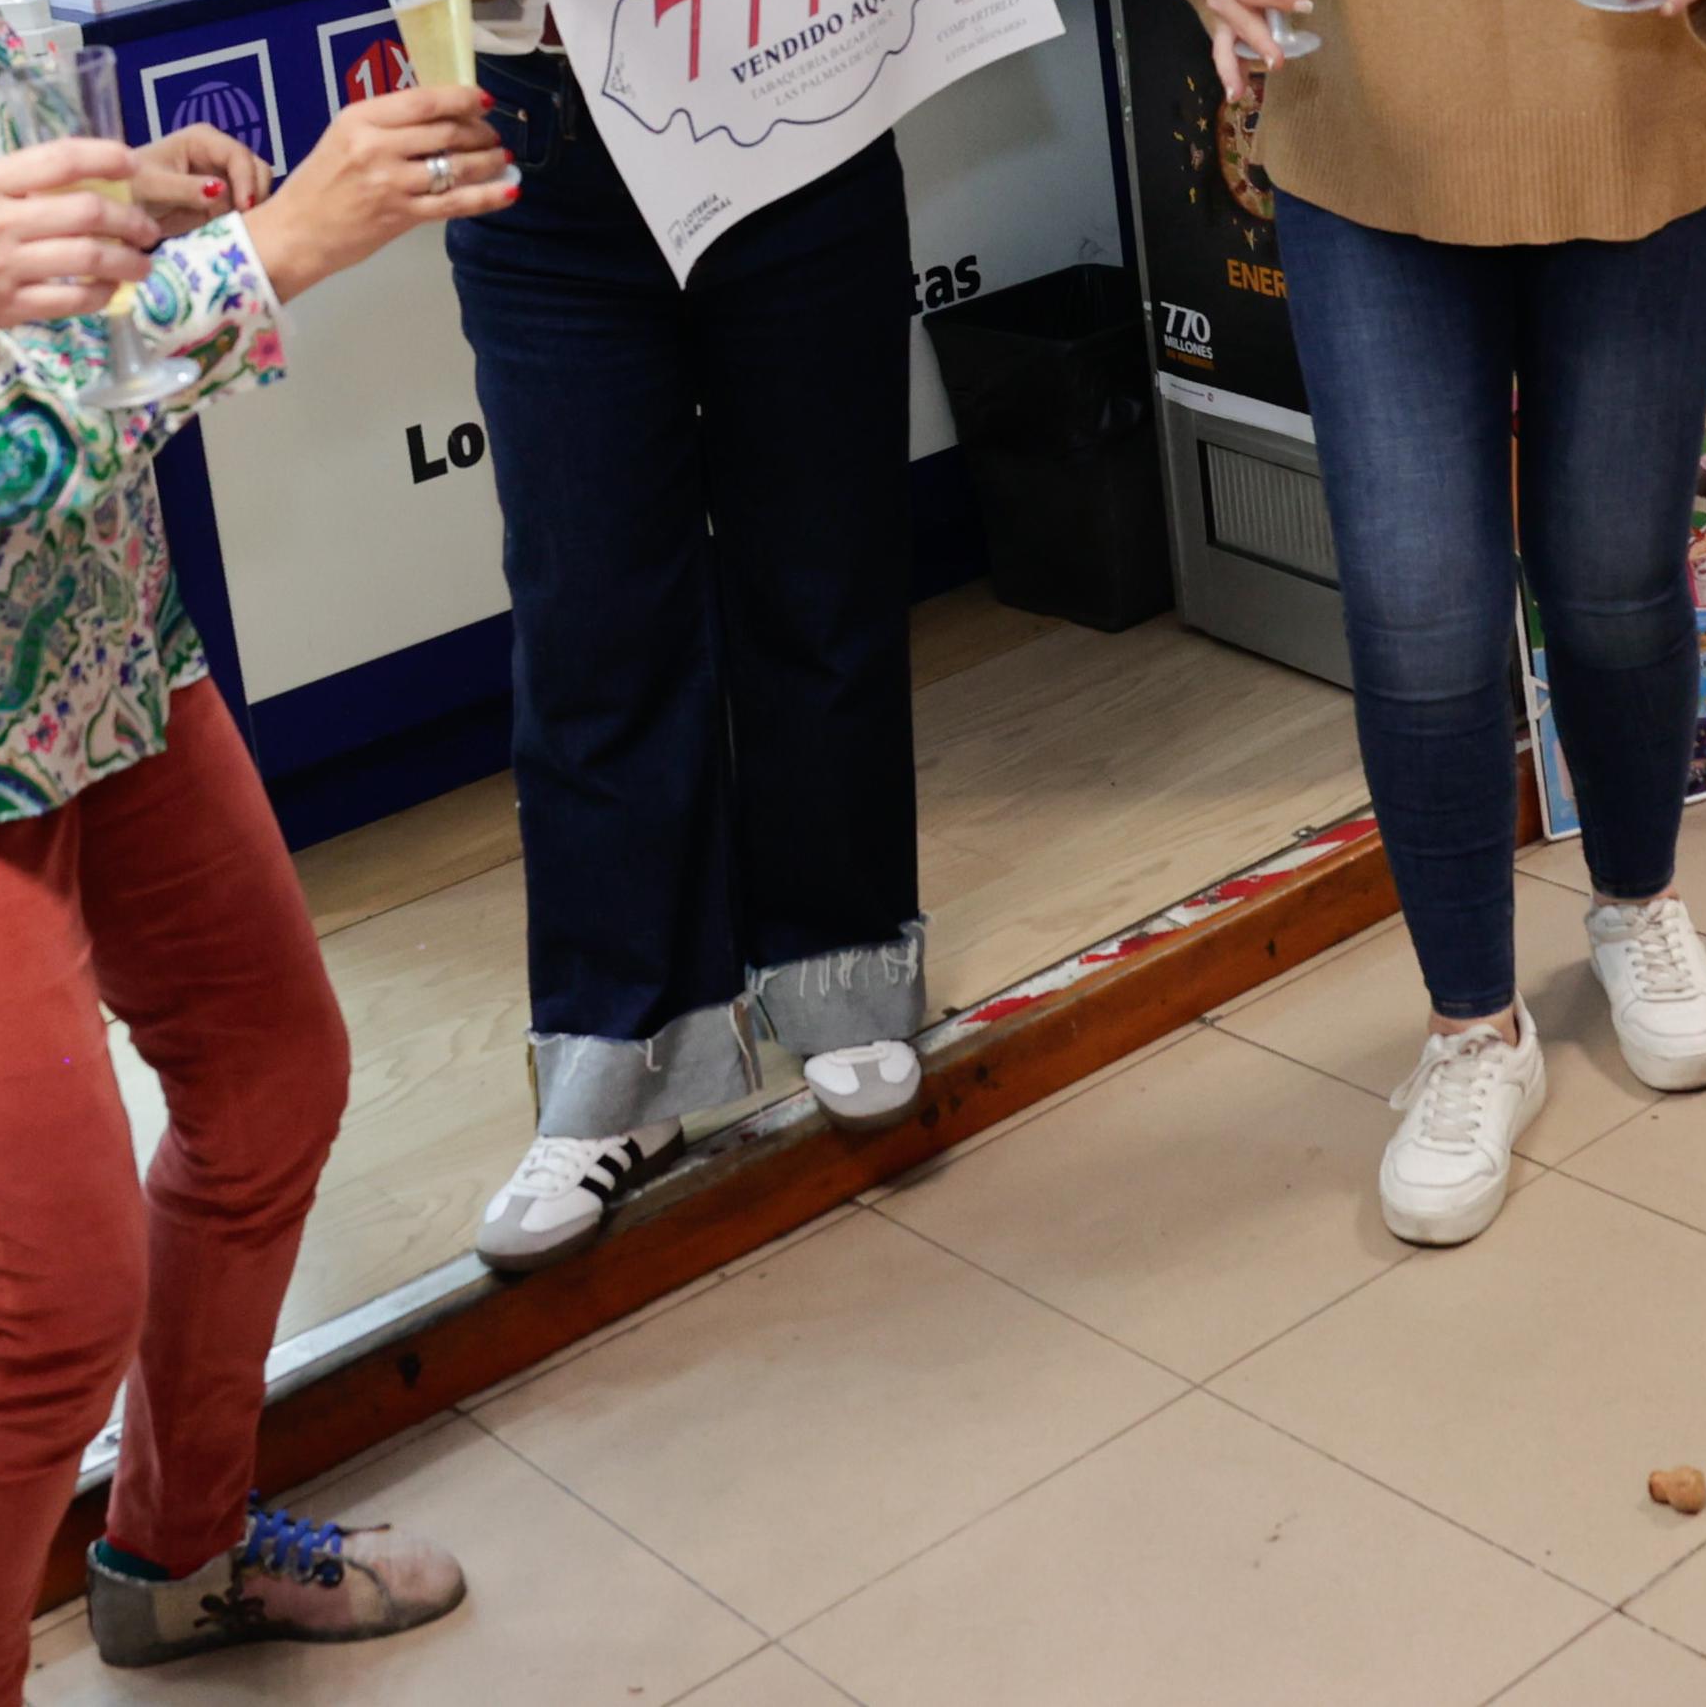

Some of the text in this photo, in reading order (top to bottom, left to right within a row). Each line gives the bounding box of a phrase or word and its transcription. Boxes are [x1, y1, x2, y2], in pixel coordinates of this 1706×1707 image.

[731, 11, 844, 85] VENDIDO
[913, 254, 982, 319] tas
[1226, 259, 1288, 299] ENER
[1160, 301, 1211, 343] 770
[1164, 334, 1214, 360] MILLONES
[407, 421, 485, 484] Lo
